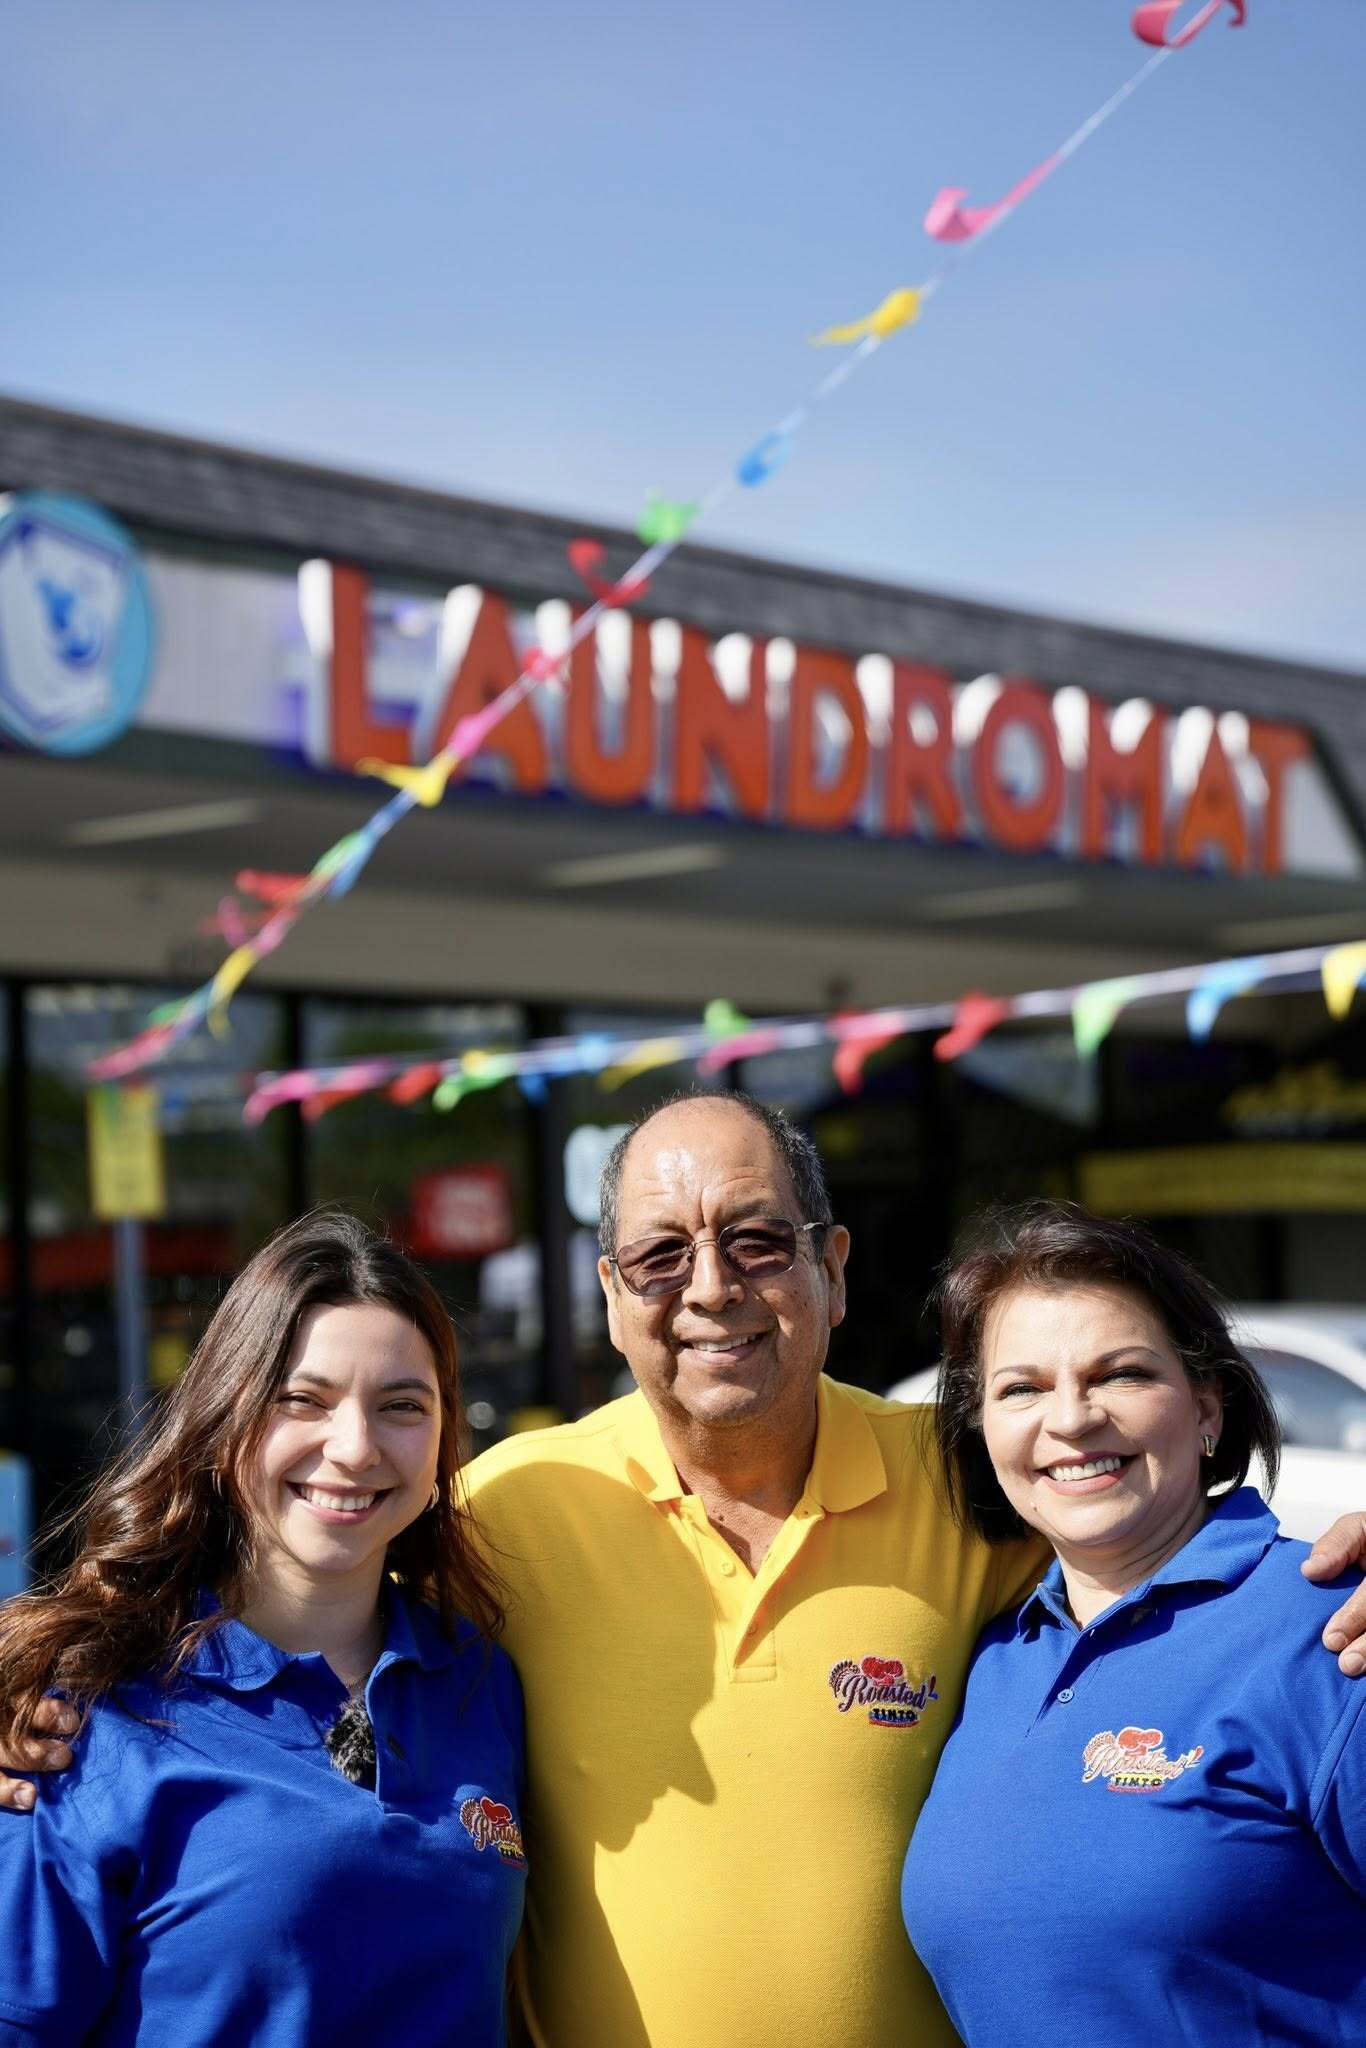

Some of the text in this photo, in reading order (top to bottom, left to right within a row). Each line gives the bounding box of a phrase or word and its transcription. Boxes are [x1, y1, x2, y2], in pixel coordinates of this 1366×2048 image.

[300, 559, 1313, 877] LAUNDROMAT
[838, 1674, 926, 1712] Roasted
[872, 1707, 918, 1722] TINTO
[1114, 1776, 1163, 1787] TINTO
